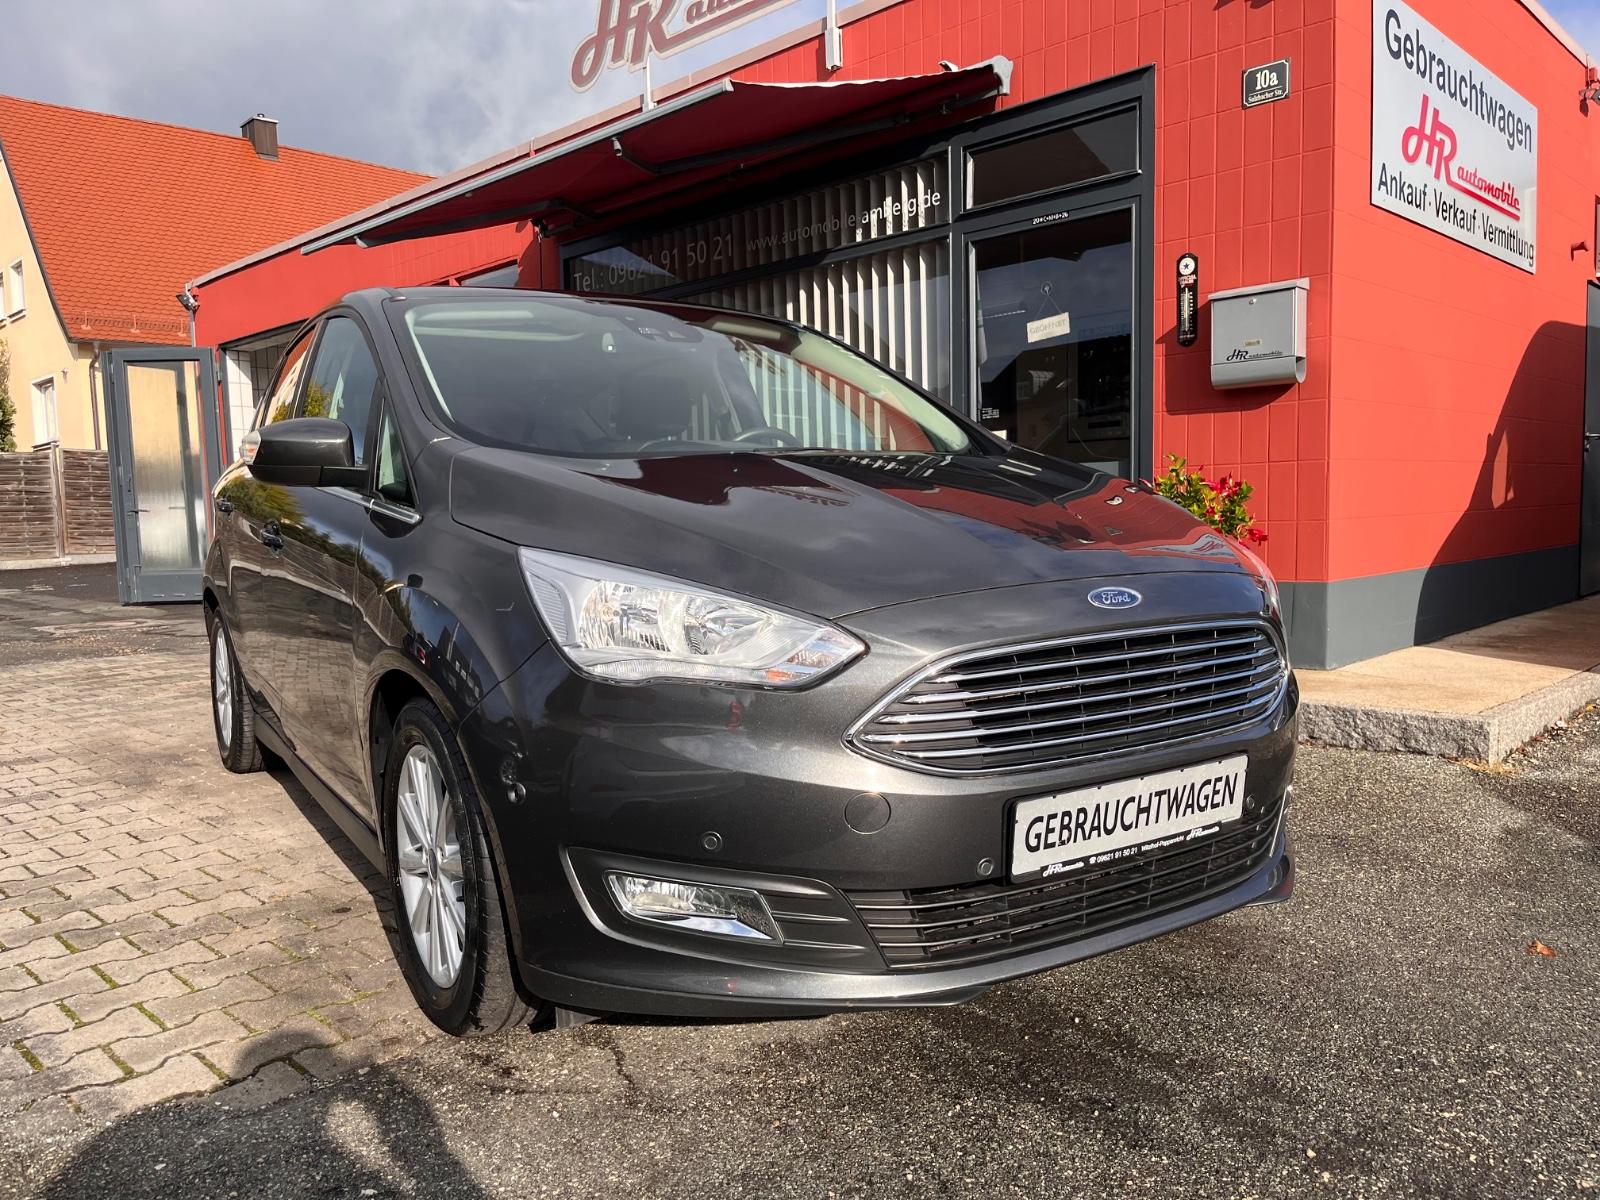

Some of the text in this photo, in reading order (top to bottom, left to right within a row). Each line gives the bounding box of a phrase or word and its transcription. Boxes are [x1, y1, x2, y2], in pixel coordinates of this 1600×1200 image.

[1255, 69, 1279, 91] 10a
[1384, 8, 1533, 153] Gebrauchtwagen
[1401, 93, 1521, 211] HR automobile
[1377, 162, 1535, 267] Ankauf Verkauf Vermittlung
[573, 267, 604, 292] Tel.:
[608, 253, 654, 286] 09621
[660, 247, 679, 273] 91
[686, 240, 707, 268] 50
[712, 233, 733, 261] 21
[1101, 591, 1131, 604] Ford
[1024, 772, 1239, 852] GEBRAUCHTWAGEN
[1096, 853, 1114, 863] 09621
[1114, 851, 1122, 859] 91
[1122, 848, 1131, 857] 50
[1130, 846, 1138, 855] 21
